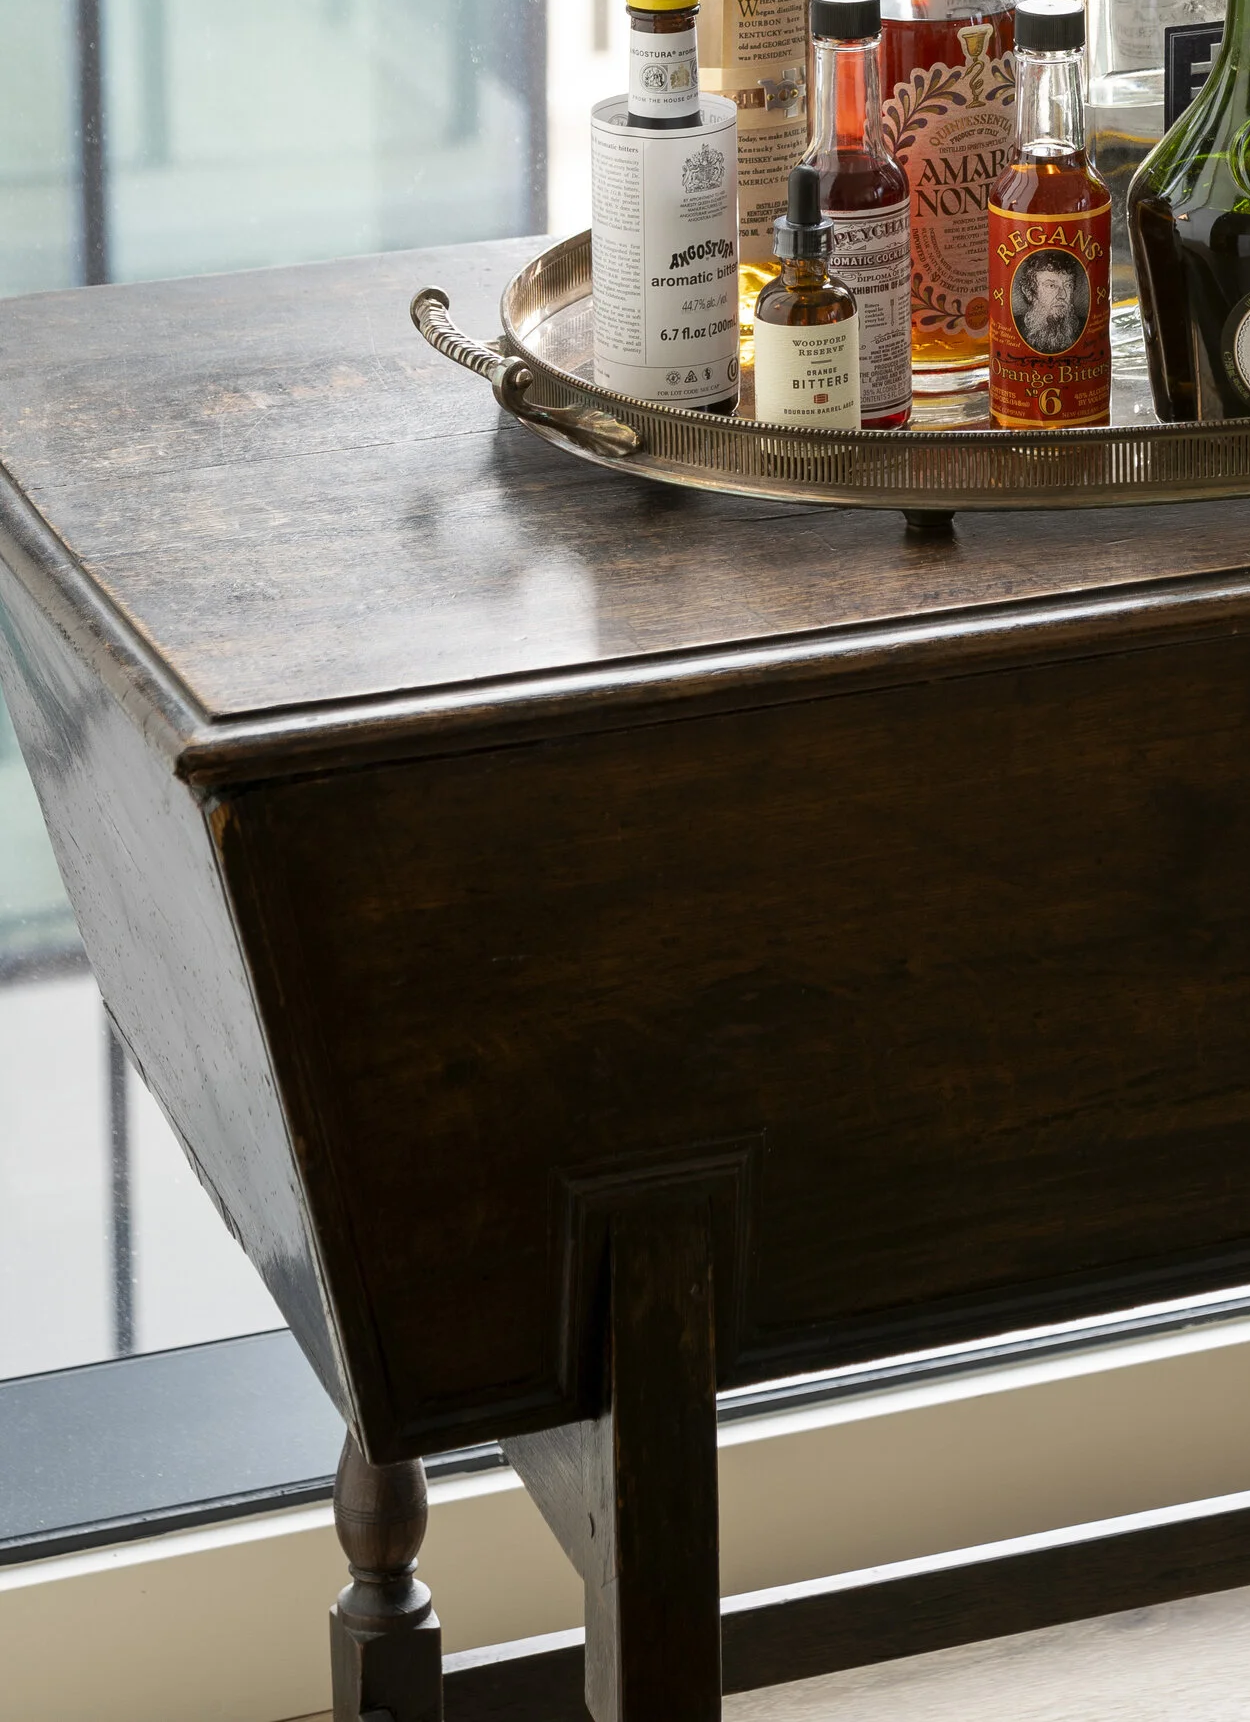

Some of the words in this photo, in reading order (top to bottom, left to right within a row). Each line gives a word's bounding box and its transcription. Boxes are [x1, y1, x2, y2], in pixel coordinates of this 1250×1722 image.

[776, 5, 802, 14] distilling
[738, 18, 782, 28] BOURBON
[738, 29, 782, 39] KENTUCKY
[738, 42, 748, 50] old
[750, 41, 762, 49] and
[762, 38, 790, 49] GEORGE
[664, 96, 685, 104] HOUSE
[950, 128, 976, 144] PRODUCT
[985, 128, 999, 137] ITALY
[618, 144, 639, 154] bitters
[738, 144, 773, 154] Kentucky
[997, 225, 1103, 266] REGANS'
[669, 239, 734, 270] ANGOSTURA
[912, 228, 926, 263] IMPORTED
[940, 279, 969, 294] TERLATO
[652, 272, 713, 287] aromatic
[858, 273, 892, 283] DIPLOMA
[660, 329, 679, 341] 6.7
[682, 326, 706, 340] fl.oz
[792, 335, 847, 347] WOODFORD
[798, 345, 845, 357] RESERVE
[806, 367, 838, 377] ORANGE
[991, 358, 1054, 388] Orange
[793, 373, 849, 389] BITTERS
[1039, 388, 1062, 415] 6
[817, 405, 842, 414] BARREL
